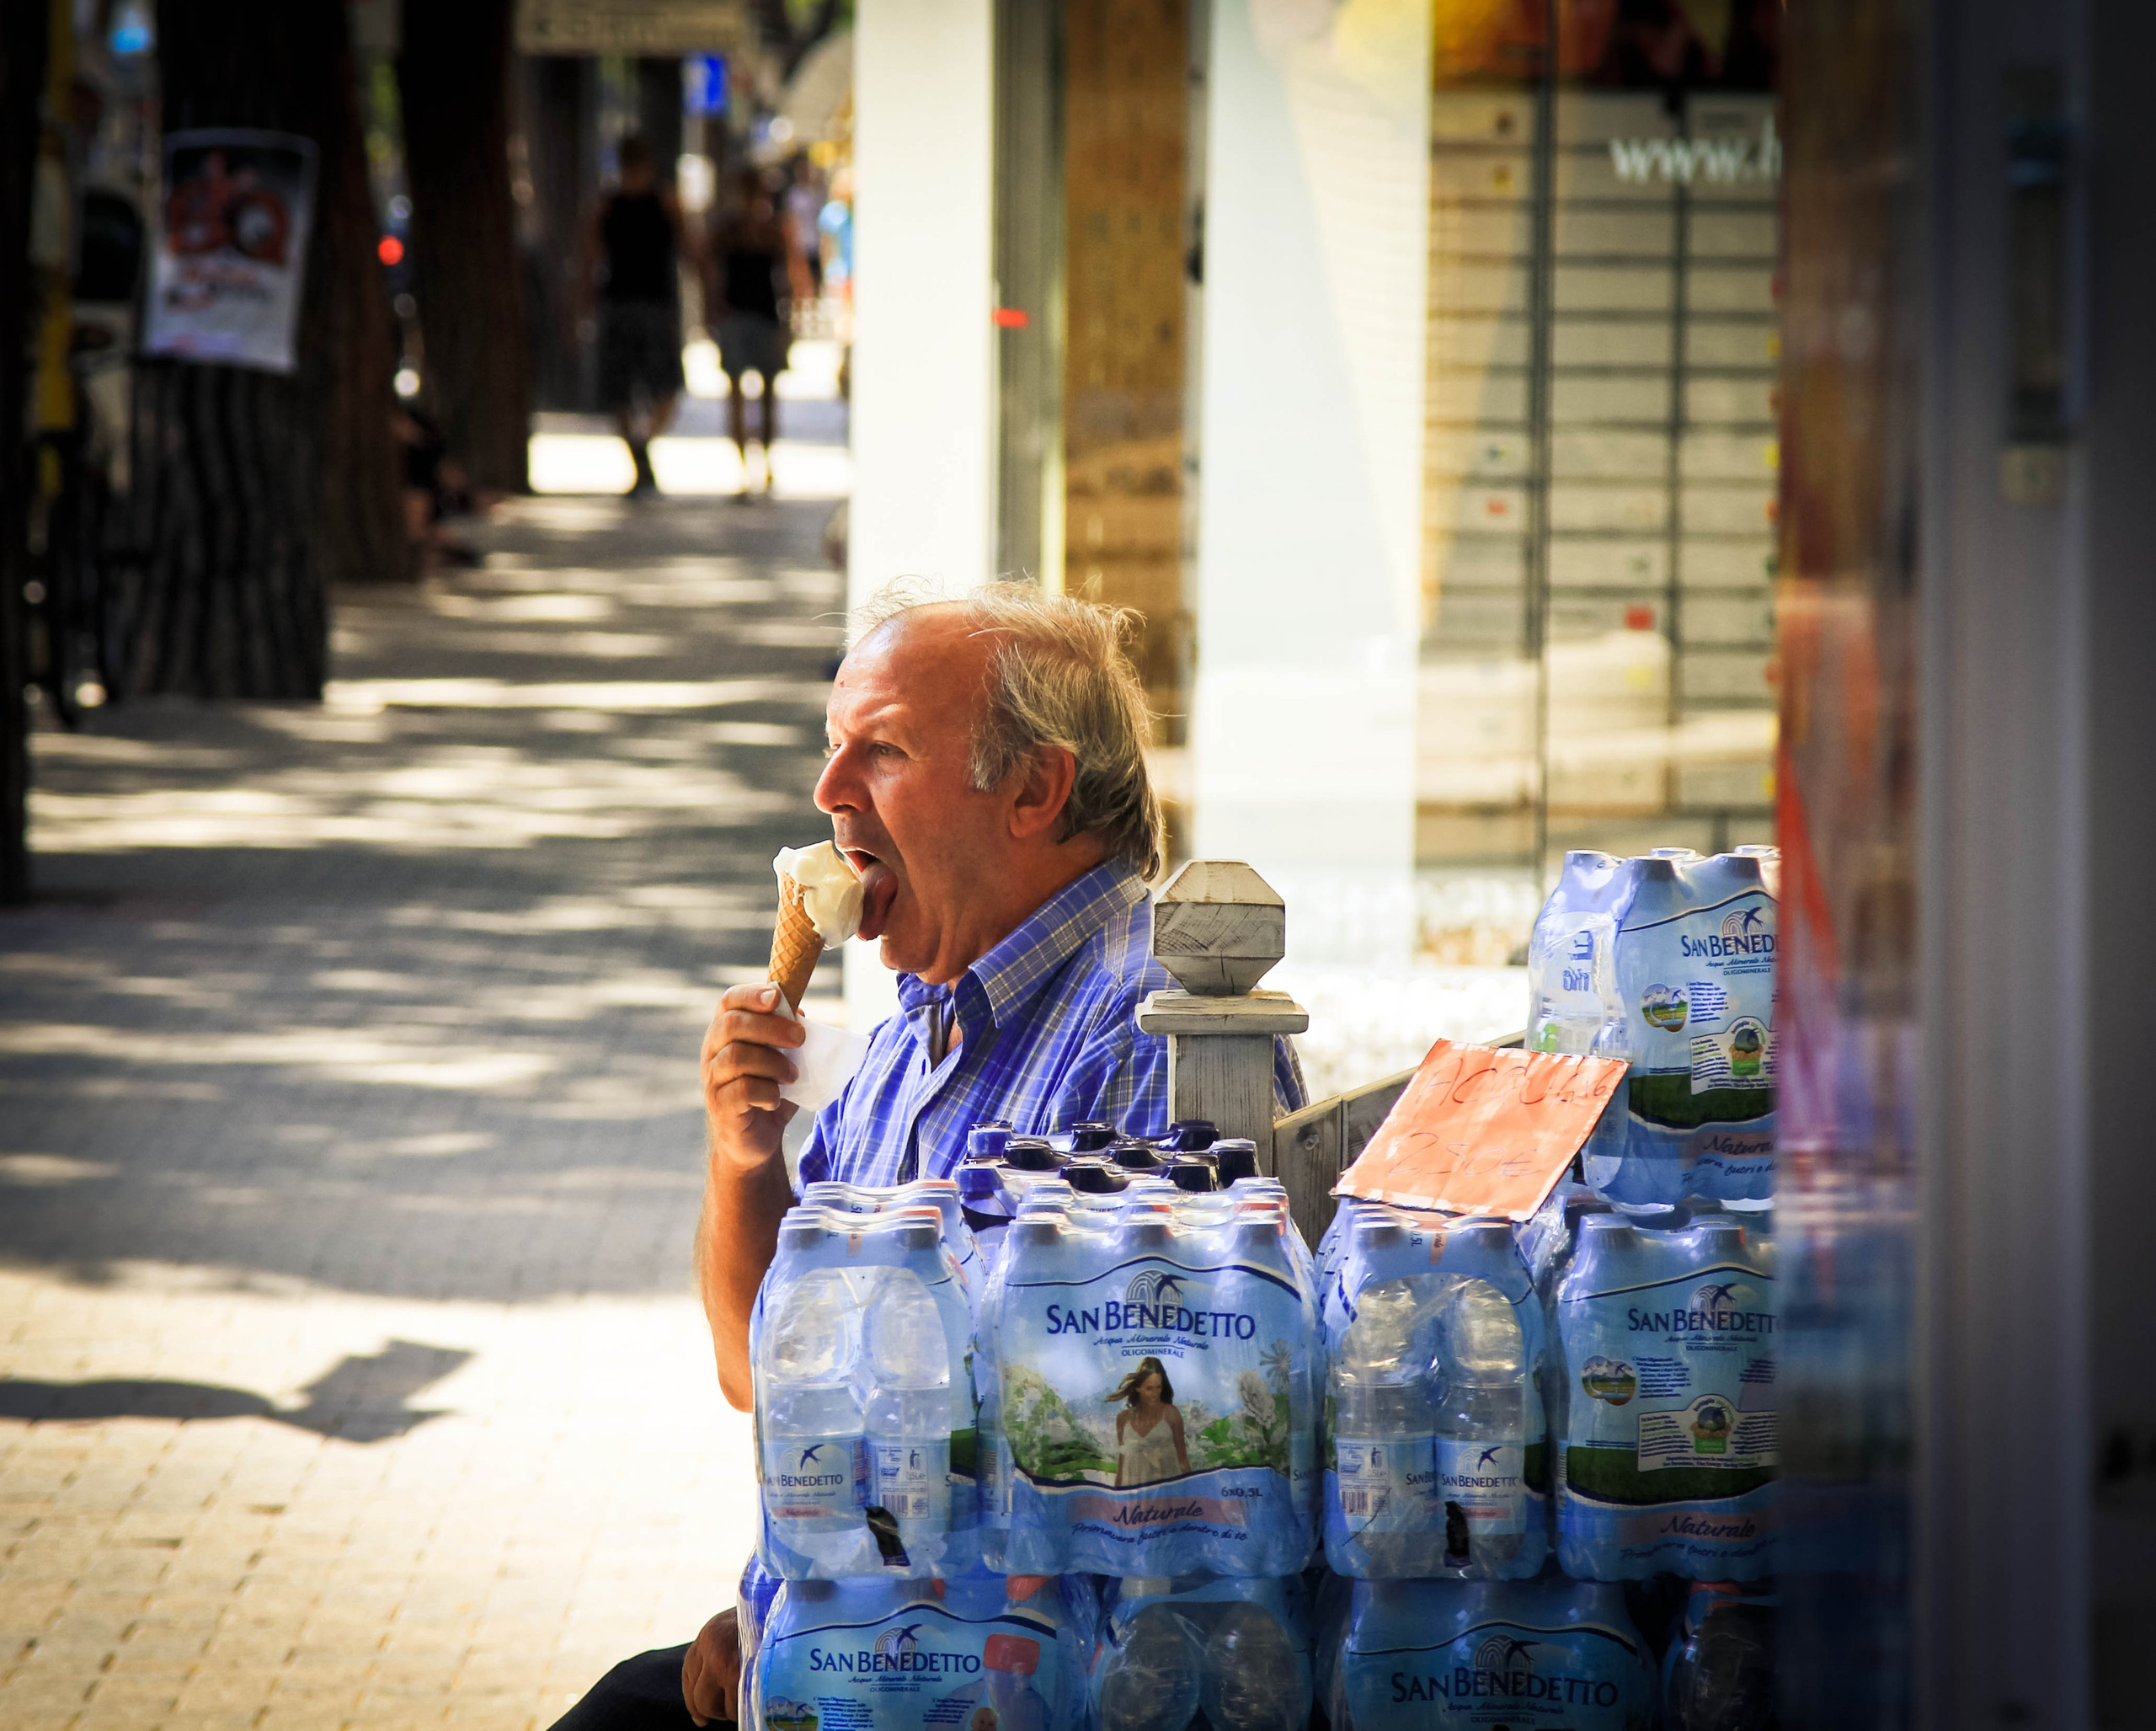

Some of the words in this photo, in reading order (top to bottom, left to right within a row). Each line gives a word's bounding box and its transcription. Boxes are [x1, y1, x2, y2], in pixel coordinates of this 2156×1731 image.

[1709, 934, 1779, 957] BENED
[1703, 1135, 1775, 1155] Natura
[1046, 1304, 1100, 1334] SAN
[1105, 1301, 1256, 1340] BENEDETTO
[1628, 1308, 1669, 1332] SAN
[1673, 1309, 1777, 1333] BENEDETT
[1094, 1336, 1123, 1347] Acqua
[1127, 1334, 1171, 1344] Minerale
[1173, 1336, 1209, 1350] Naturale
[1121, 1348, 1185, 1359] OLIGOMINERALE
[781, 1474, 844, 1487] BENEDETTO
[1113, 1501, 1204, 1525] Naturale
[1660, 1515, 1756, 1538] Naturale
[809, 1648, 853, 1672] SAN
[857, 1651, 980, 1673] BENEDETTO
[848, 1675, 872, 1685] Acqua
[1391, 1672, 1449, 1702] SAN
[1454, 1667, 1619, 1707] BENEDETTO
